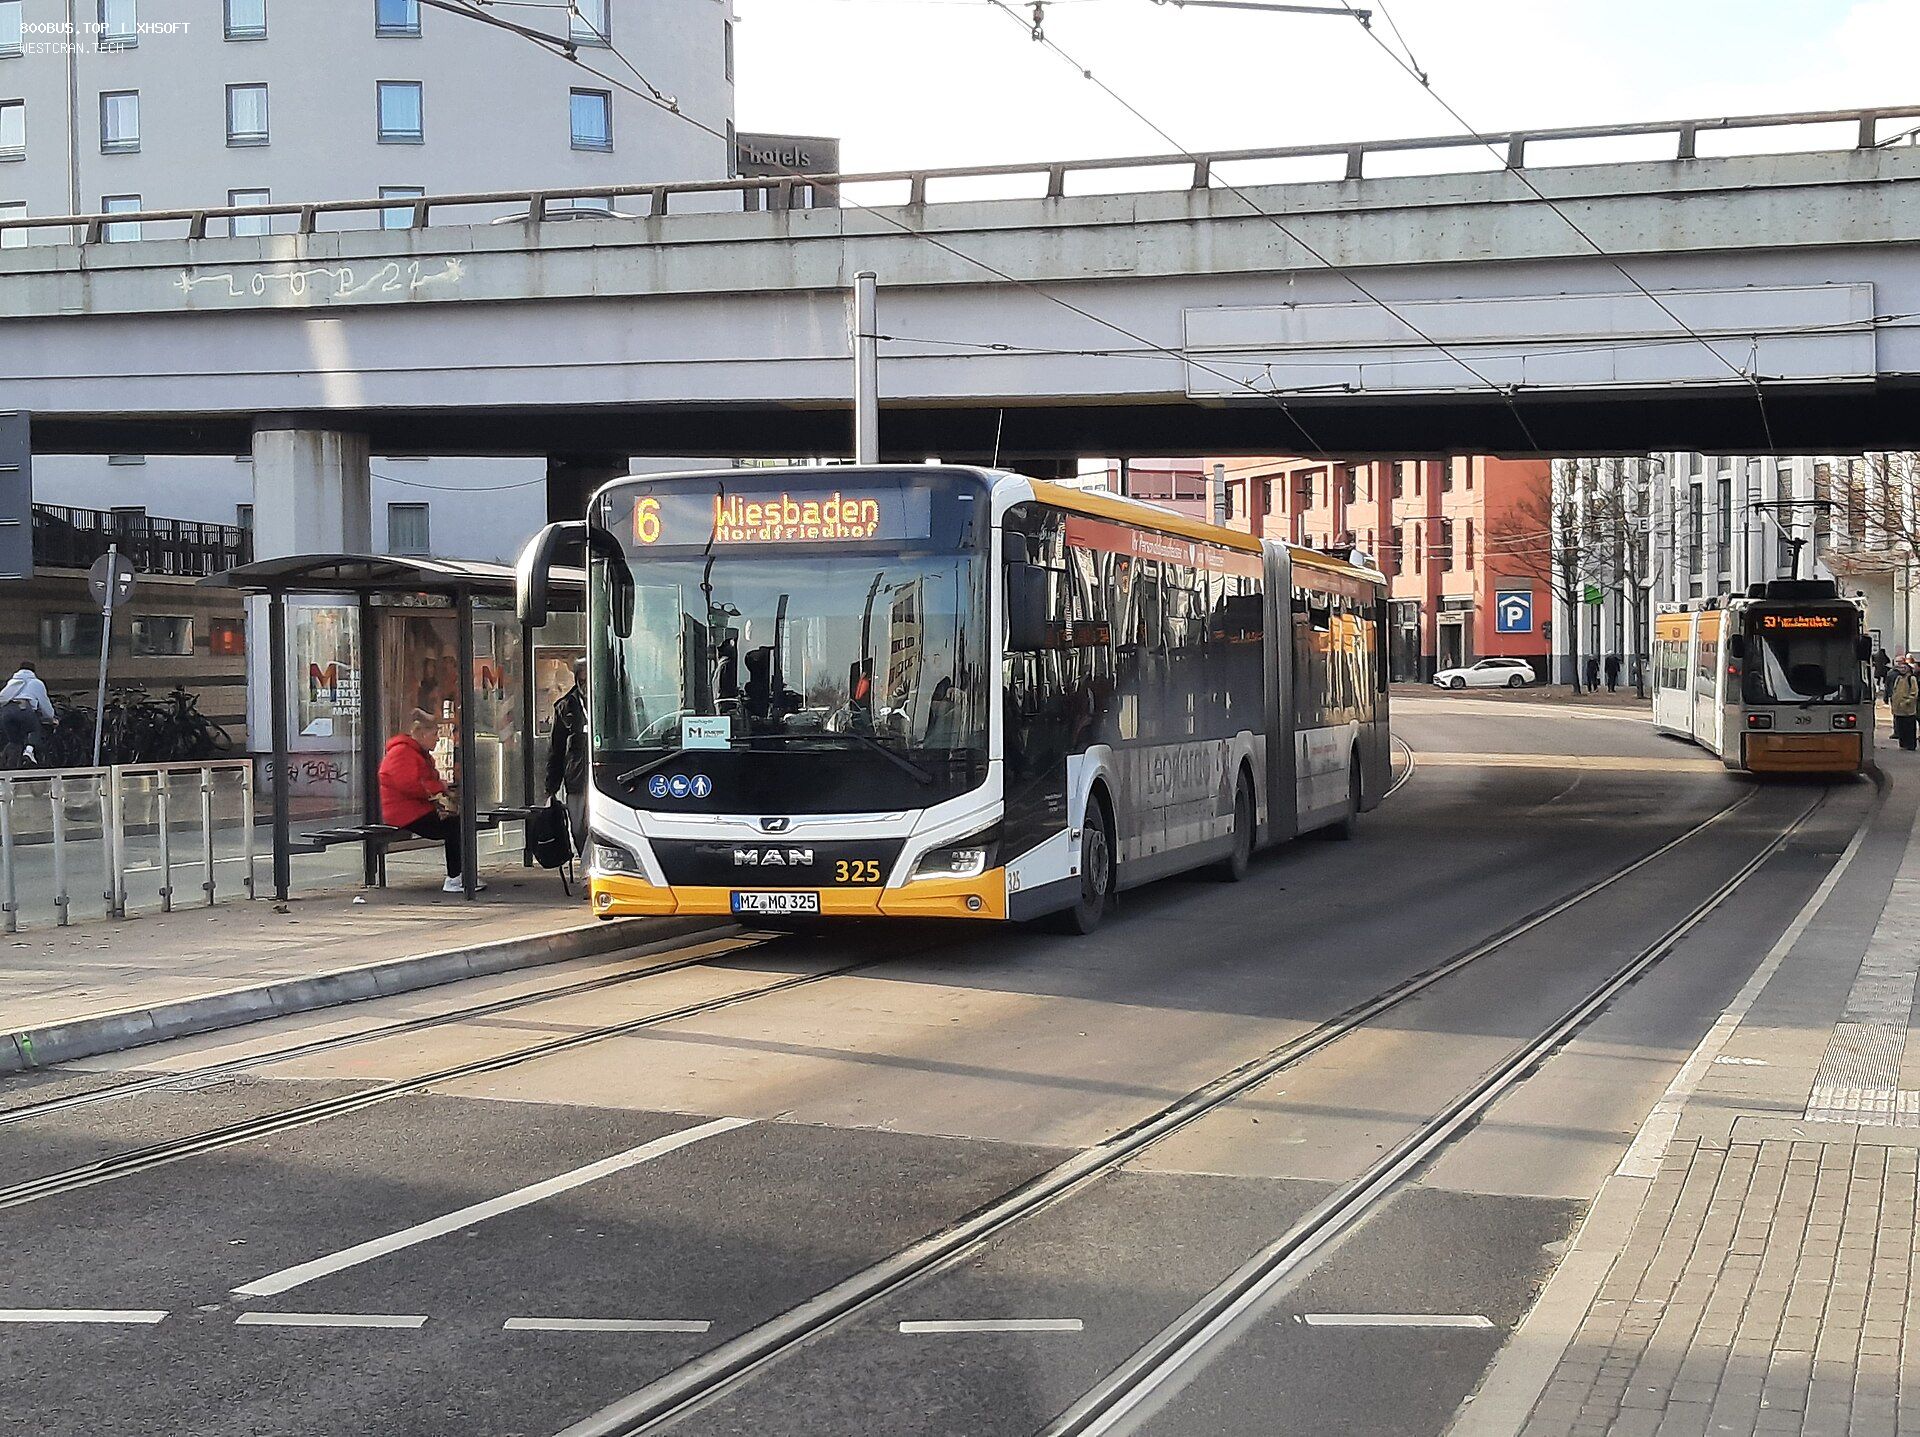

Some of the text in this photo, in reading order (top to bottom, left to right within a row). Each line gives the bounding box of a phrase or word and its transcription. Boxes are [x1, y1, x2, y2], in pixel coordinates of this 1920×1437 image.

[750, 144, 811, 167] hotels
[637, 498, 661, 543] 6
[715, 492, 880, 527] Wiesbaden
[716, 521, 879, 542] Nordfriedhof
[1507, 606, 1523, 627] P
[733, 849, 814, 866] MAN
[834, 859, 881, 882] 325
[740, 895, 816, 909] MZ MQ 325
